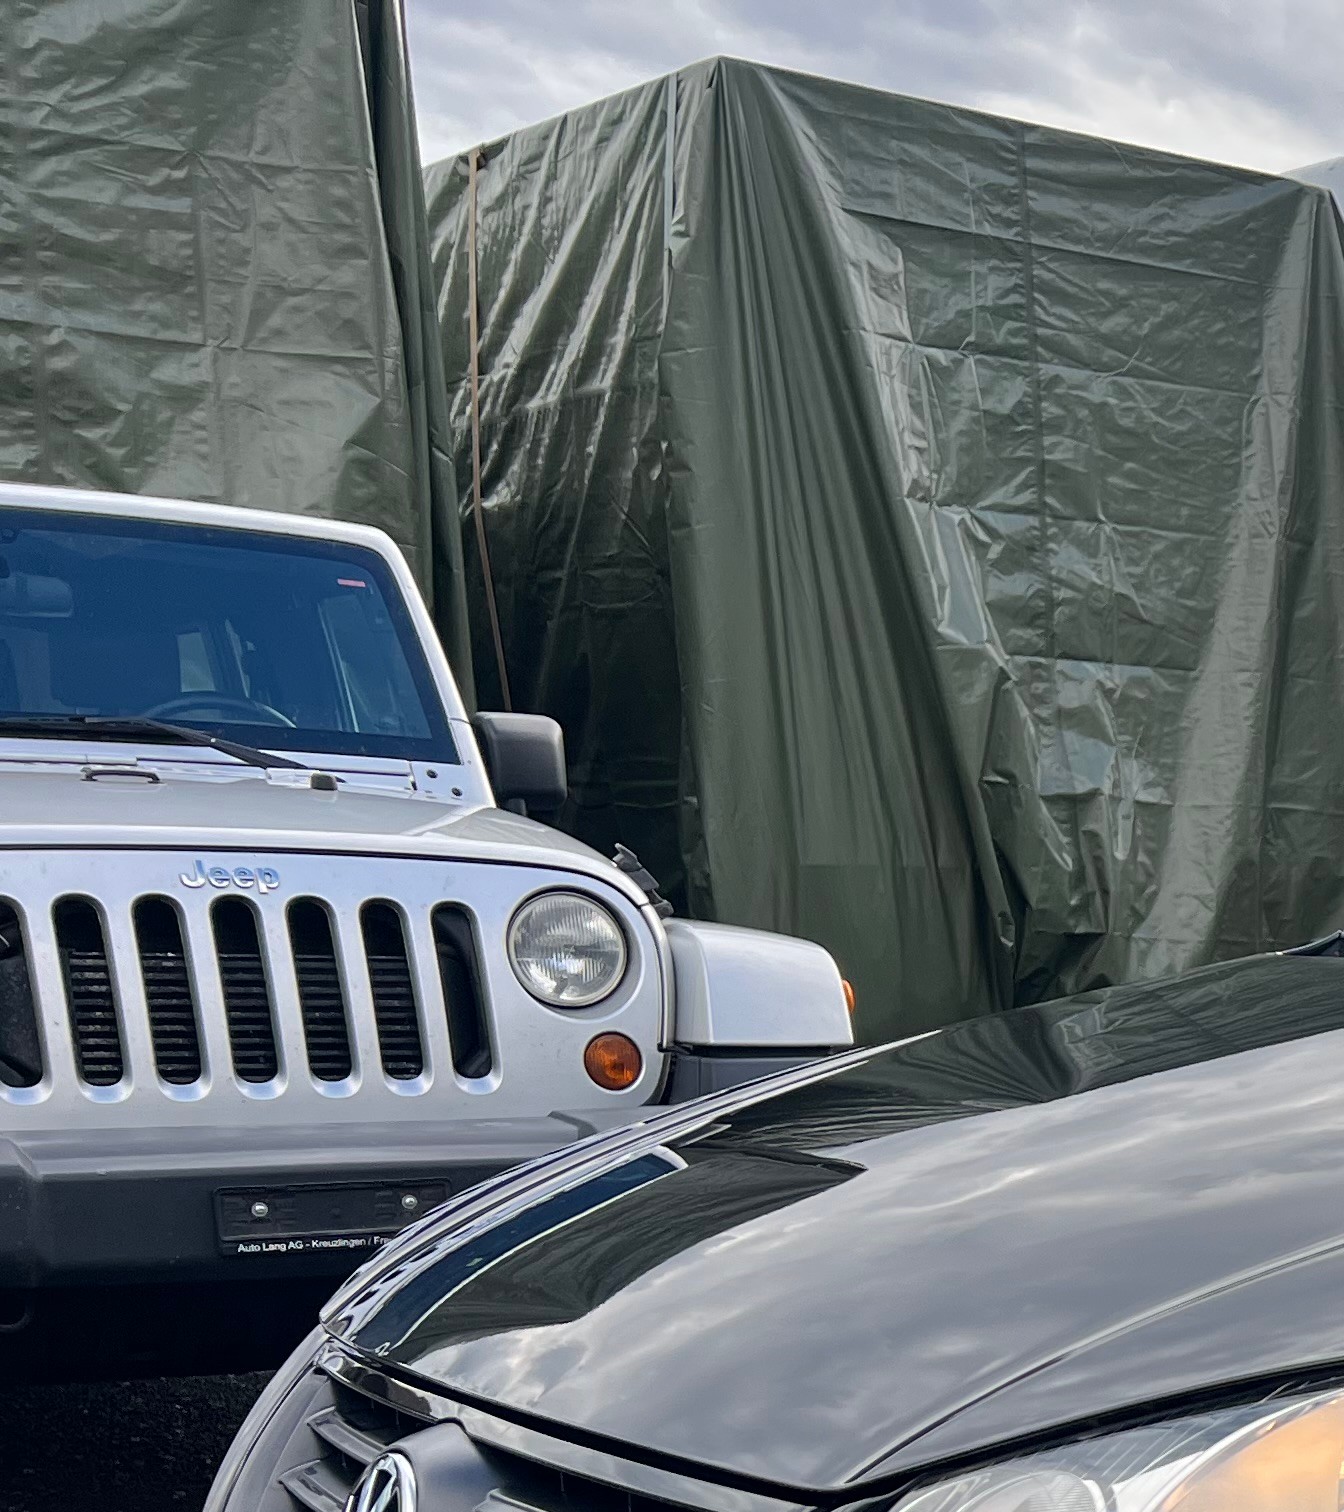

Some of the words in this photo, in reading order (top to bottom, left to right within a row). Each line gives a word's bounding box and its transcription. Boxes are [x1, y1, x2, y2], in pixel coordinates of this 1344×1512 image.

[178, 859, 281, 895] Jeep
[238, 1243, 261, 1252] Auto
[262, 1242, 287, 1252] Lang
[288, 1240, 304, 1249] AG
[311, 1238, 366, 1248] Kreuzlingen
